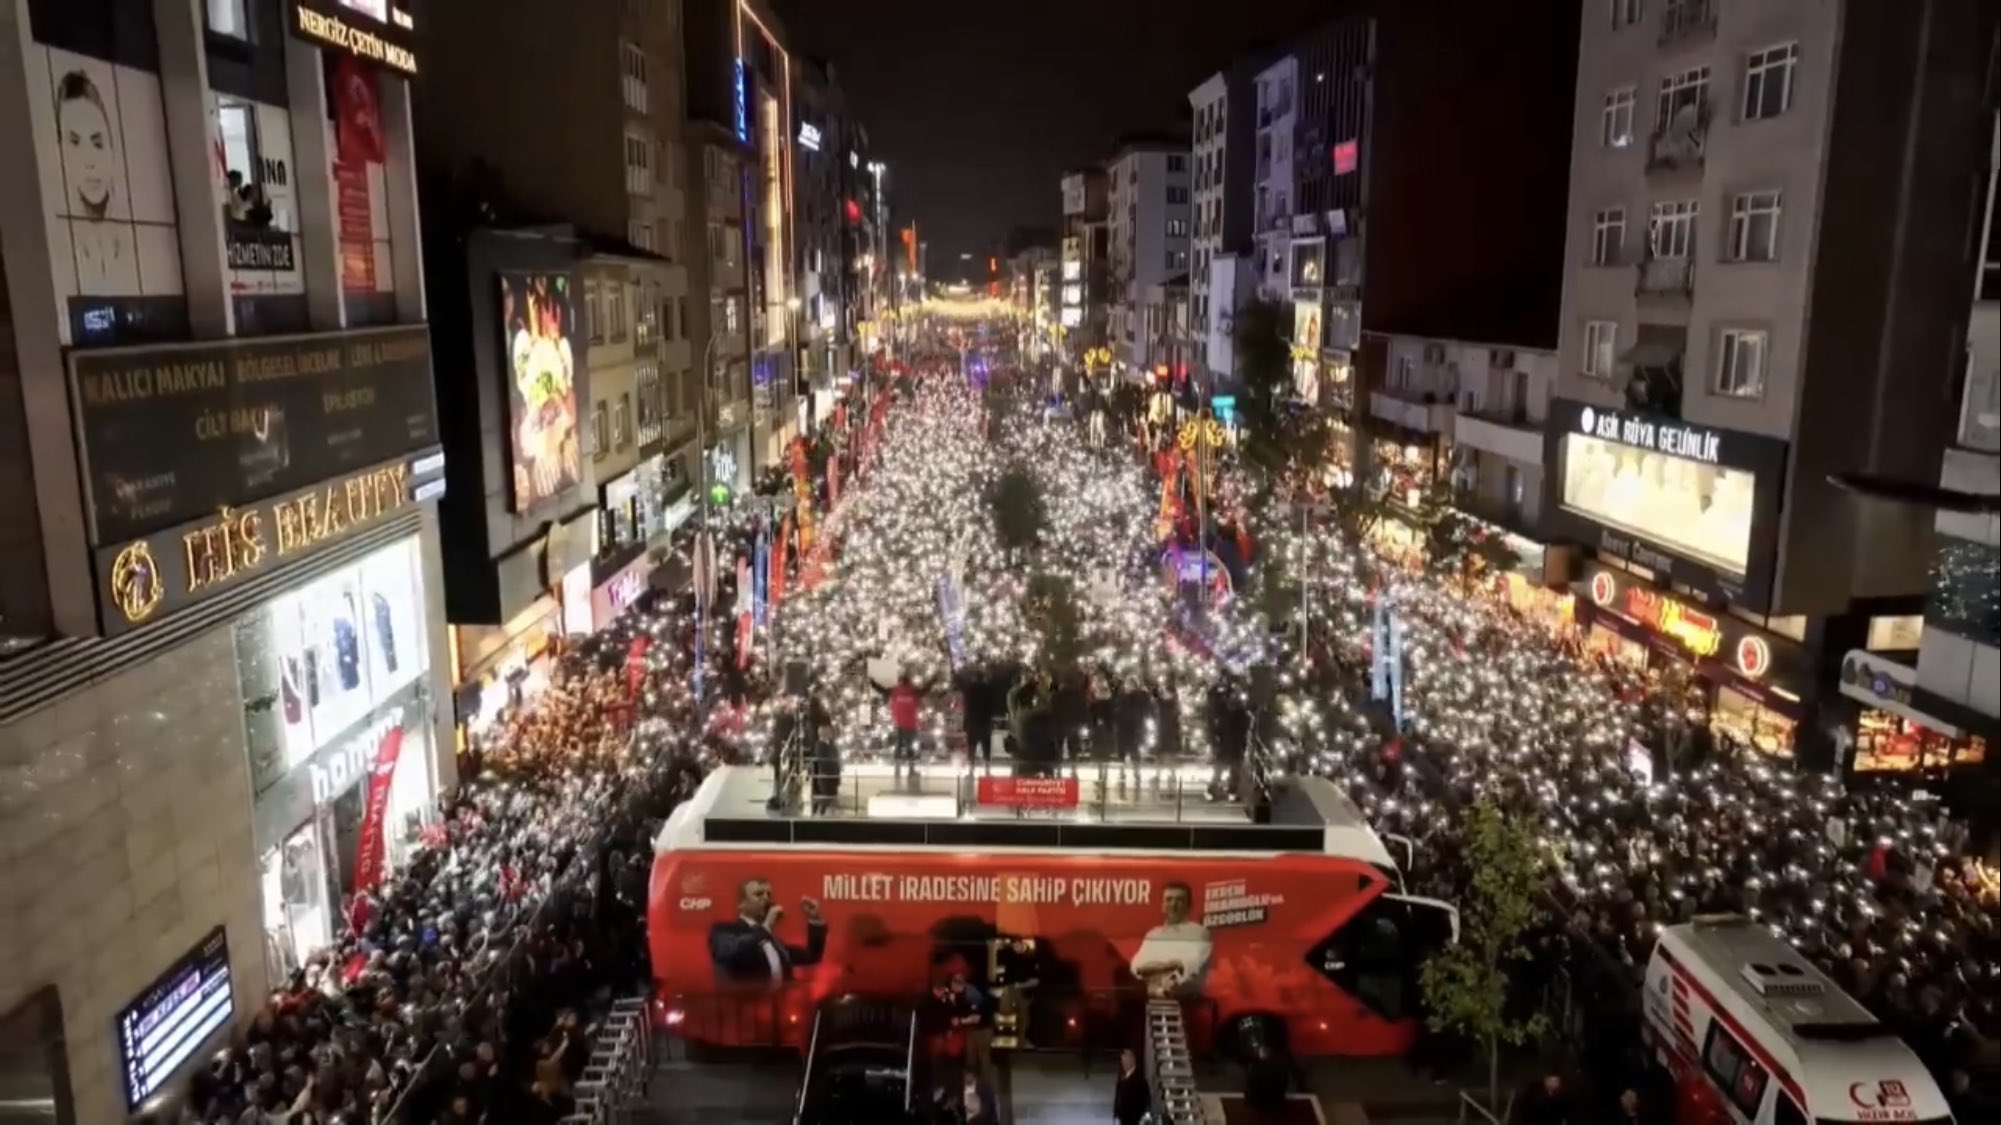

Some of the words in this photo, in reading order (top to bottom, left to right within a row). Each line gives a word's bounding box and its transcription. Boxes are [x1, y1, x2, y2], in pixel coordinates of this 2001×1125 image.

[297, 5, 349, 47] NERGİZ
[384, 42, 417, 73] MODA
[155, 360, 226, 396] MAKYAJ
[1622, 416, 1655, 448] RÜYA
[1658, 421, 1720, 463] GELİNLİK
[272, 463, 408, 556] BEAUTY
[680, 897, 712, 910] CHP
[823, 874, 893, 900] MİLLET
[899, 874, 1000, 902] İRADESİNE
[1006, 876, 1066, 903] SAHİP
[1071, 878, 1151, 907] ÇIKIYOR
